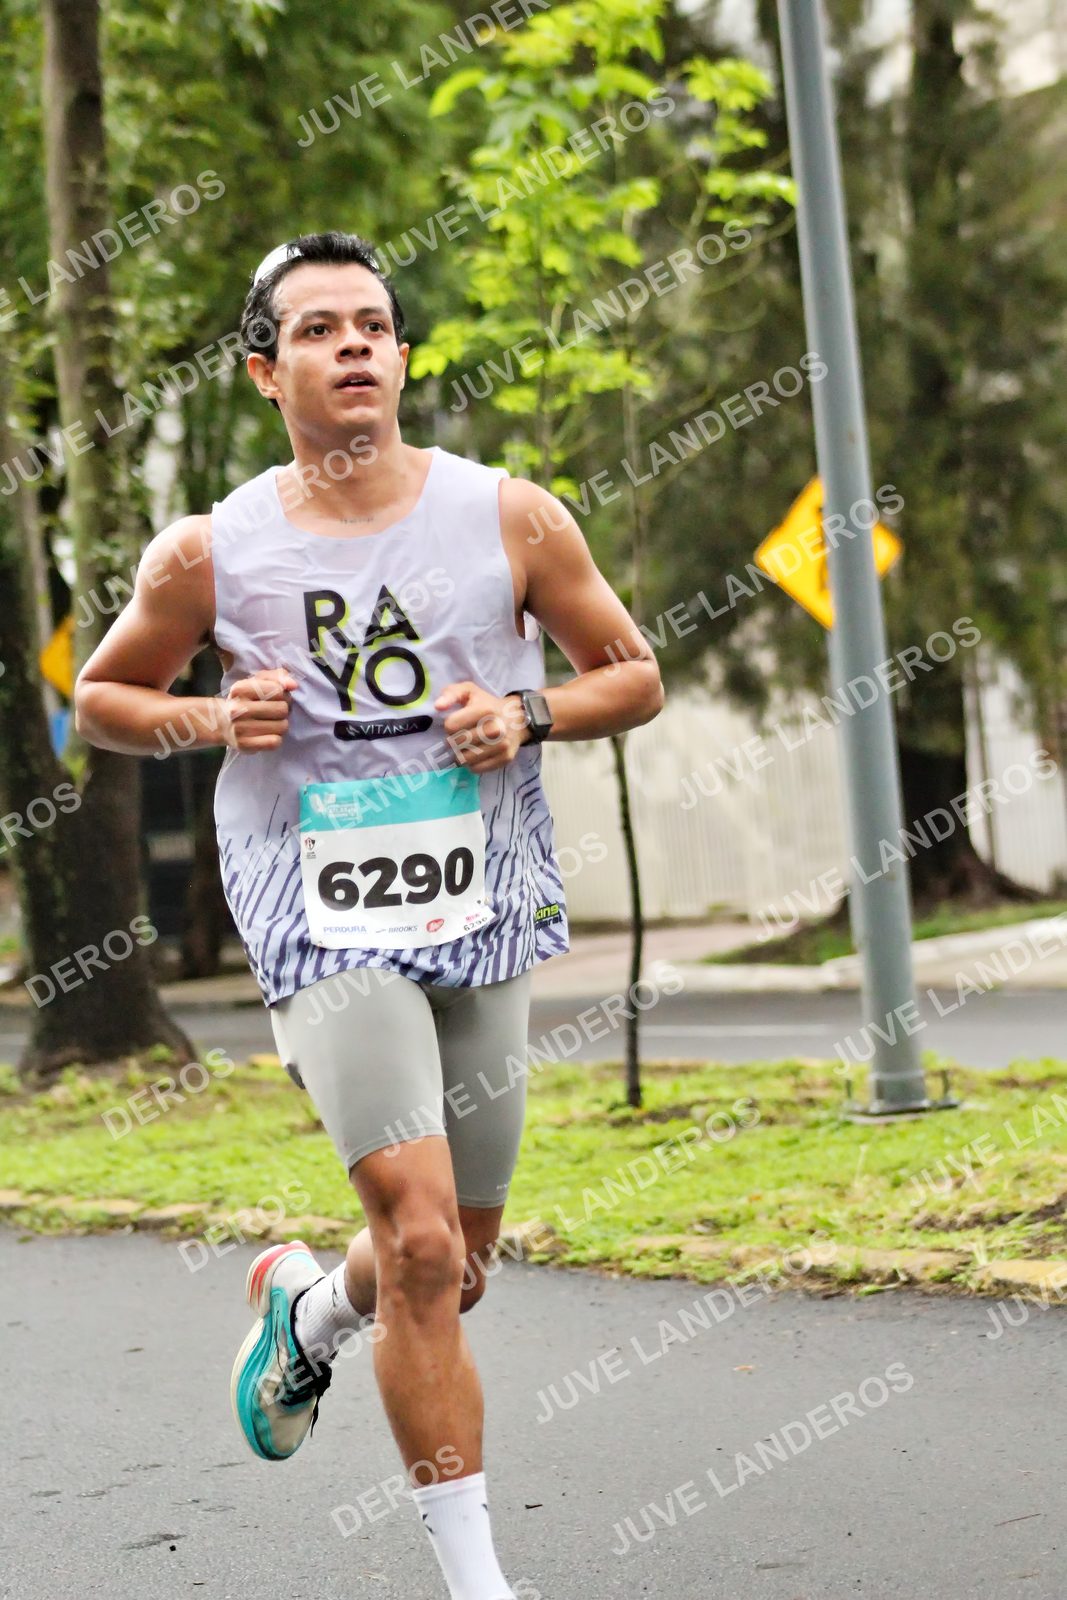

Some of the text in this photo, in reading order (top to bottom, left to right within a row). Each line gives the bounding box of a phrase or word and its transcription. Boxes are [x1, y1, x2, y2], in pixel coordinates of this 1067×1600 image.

[303, 584, 421, 653] RA
[311, 646, 426, 711] YO
[317, 846, 475, 911] 6290
[323, 925, 367, 934] PERDURA
[388, 925, 418, 933] BROOKS
